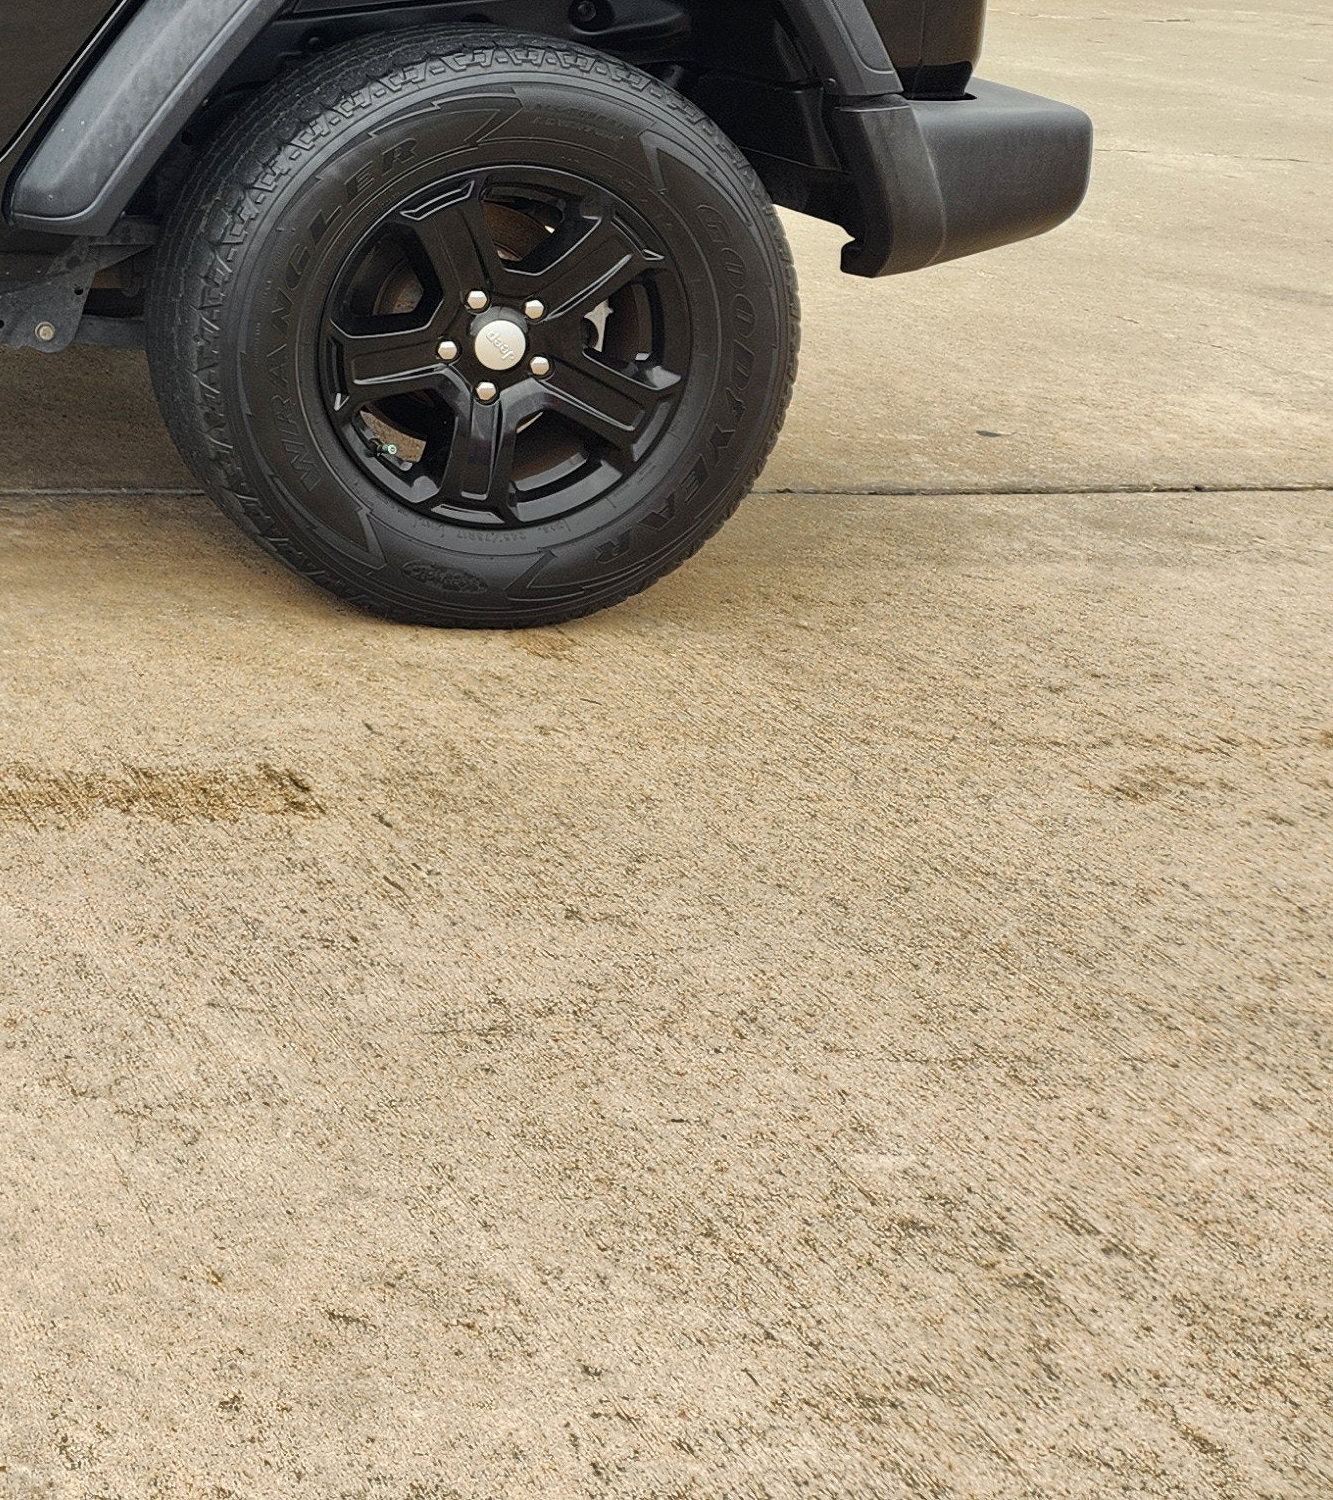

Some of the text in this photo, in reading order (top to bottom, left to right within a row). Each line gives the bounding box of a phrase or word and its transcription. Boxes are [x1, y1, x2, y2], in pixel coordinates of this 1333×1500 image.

[266, 137, 418, 492] WRANGLER
[485, 329, 515, 361] Jeep
[595, 204, 756, 565] GOODYEAR
